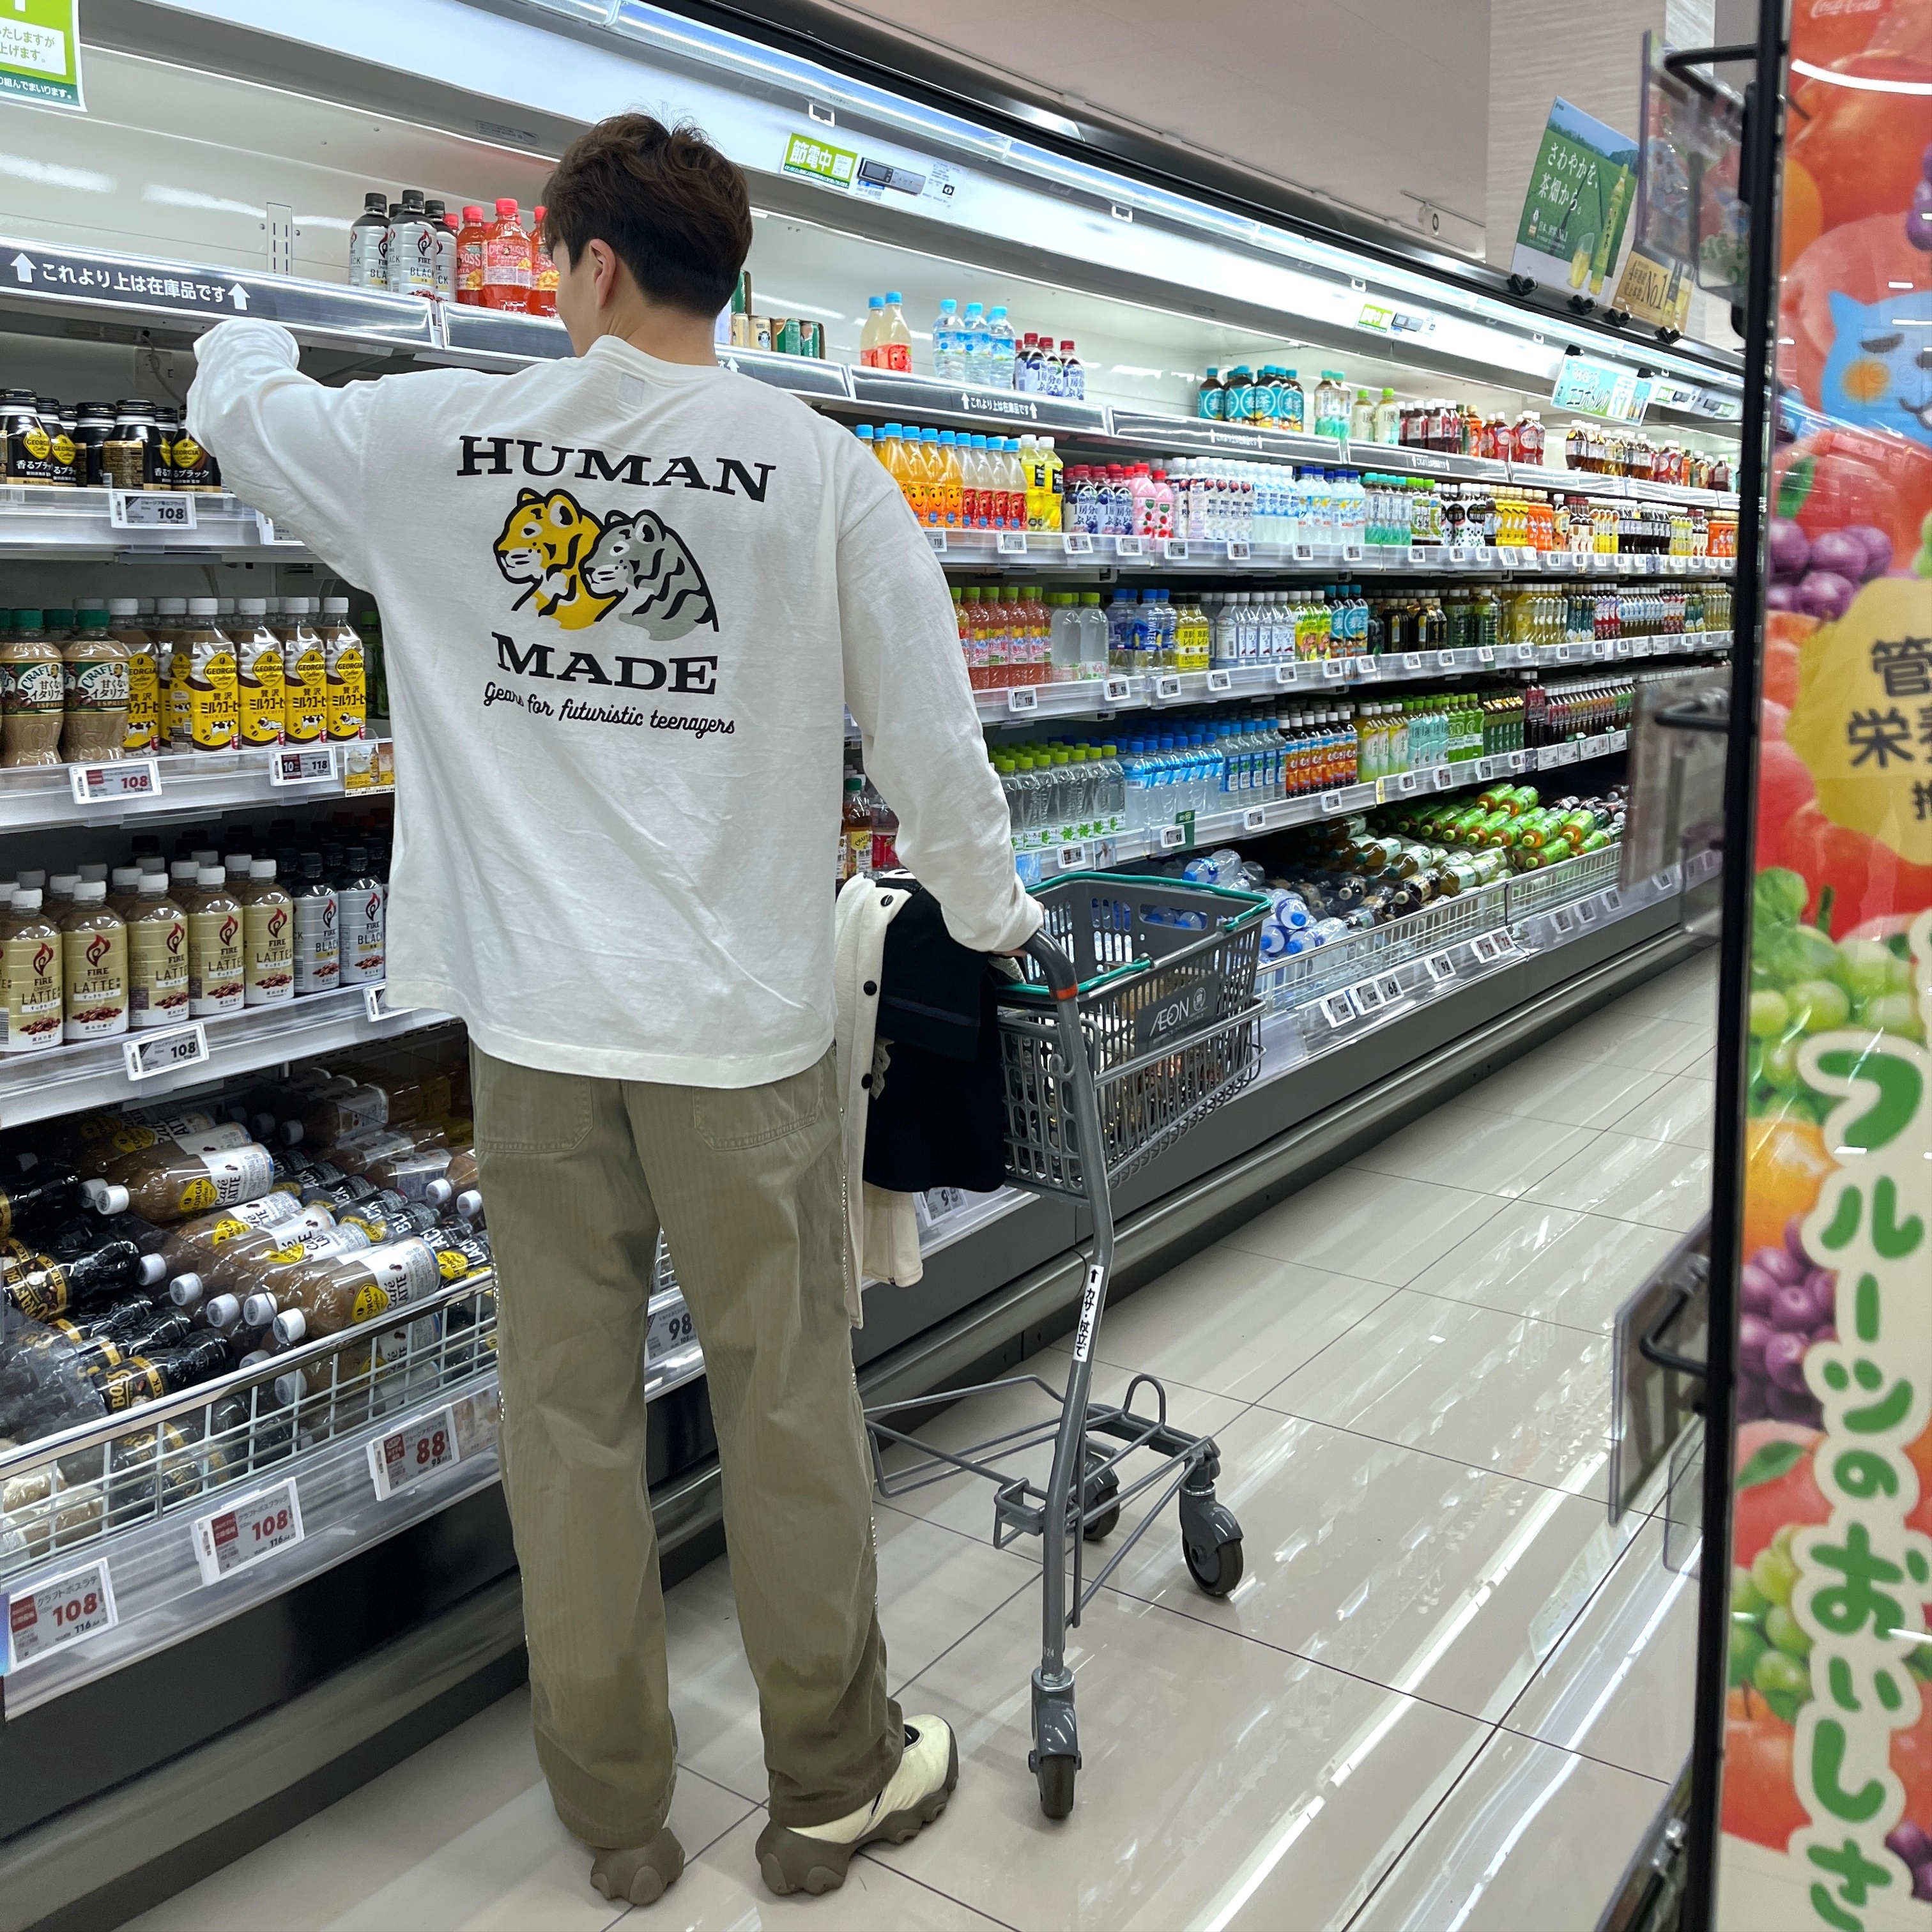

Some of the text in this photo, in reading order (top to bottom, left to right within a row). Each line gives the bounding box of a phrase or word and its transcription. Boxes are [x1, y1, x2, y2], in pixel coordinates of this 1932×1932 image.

[0, 26, 55, 49] たしますが
[790, 139, 832, 172] 節電中
[1547, 142, 1598, 189] さわやかを、
[1537, 172, 1583, 215] 茶畑から。
[460, 253, 481, 267] BOSS
[535, 254, 552, 267] OSS
[370, 268, 388, 279] BLA
[42, 263, 227, 303] これより上は在庫品です
[173, 470, 210, 478] るブラック
[457, 435, 777, 503] HUMAN
[158, 508, 184, 519] 108
[491, 631, 718, 695] MADE
[20, 664, 50, 690] CRAFT
[81, 664, 113, 689] CRAFT
[31, 690, 64, 700] イタリアー
[91, 689, 128, 699] イタリアー
[332, 694, 365, 706] ミルクコーヒ
[201, 701, 238, 714] ミルクコーヒ
[249, 697, 285, 710] ミルクコーヒ
[293, 696, 326, 708] ミルクコーヒ
[527, 693, 555, 717] for
[559, 698, 644, 726] futuristic
[650, 709, 736, 739] teenagers
[1847, 707, 1932, 767] 栄
[283, 761, 295, 772] 10
[311, 760, 328, 770] 118
[121, 775, 148, 789] 108
[366, 921, 380, 930] FIRE
[268, 939, 286, 947] FIRE
[316, 939, 339, 953] BLAC
[220, 946, 238, 956] FIRE
[256, 949, 289, 963] LATTE
[168, 954, 185, 964] FIRE
[87, 967, 109, 976] FIRE
[34, 976, 53, 986] FIRE
[73, 978, 115, 994] LATTE
[1388, 981, 1398, 995] 68
[22, 988, 57, 1005] LATTE
[171, 1041, 196, 1059] 108
[214, 1178, 229, 1206] Café
[668, 1313, 693, 1341] 98
[1076, 1287, 1095, 1357] カサ・杖立て
[106, 1368, 133, 1409] BOSS
[417, 1430, 445, 1464] 88
[252, 1509, 288, 1542] 108
[52, 1592, 98, 1627] 108
